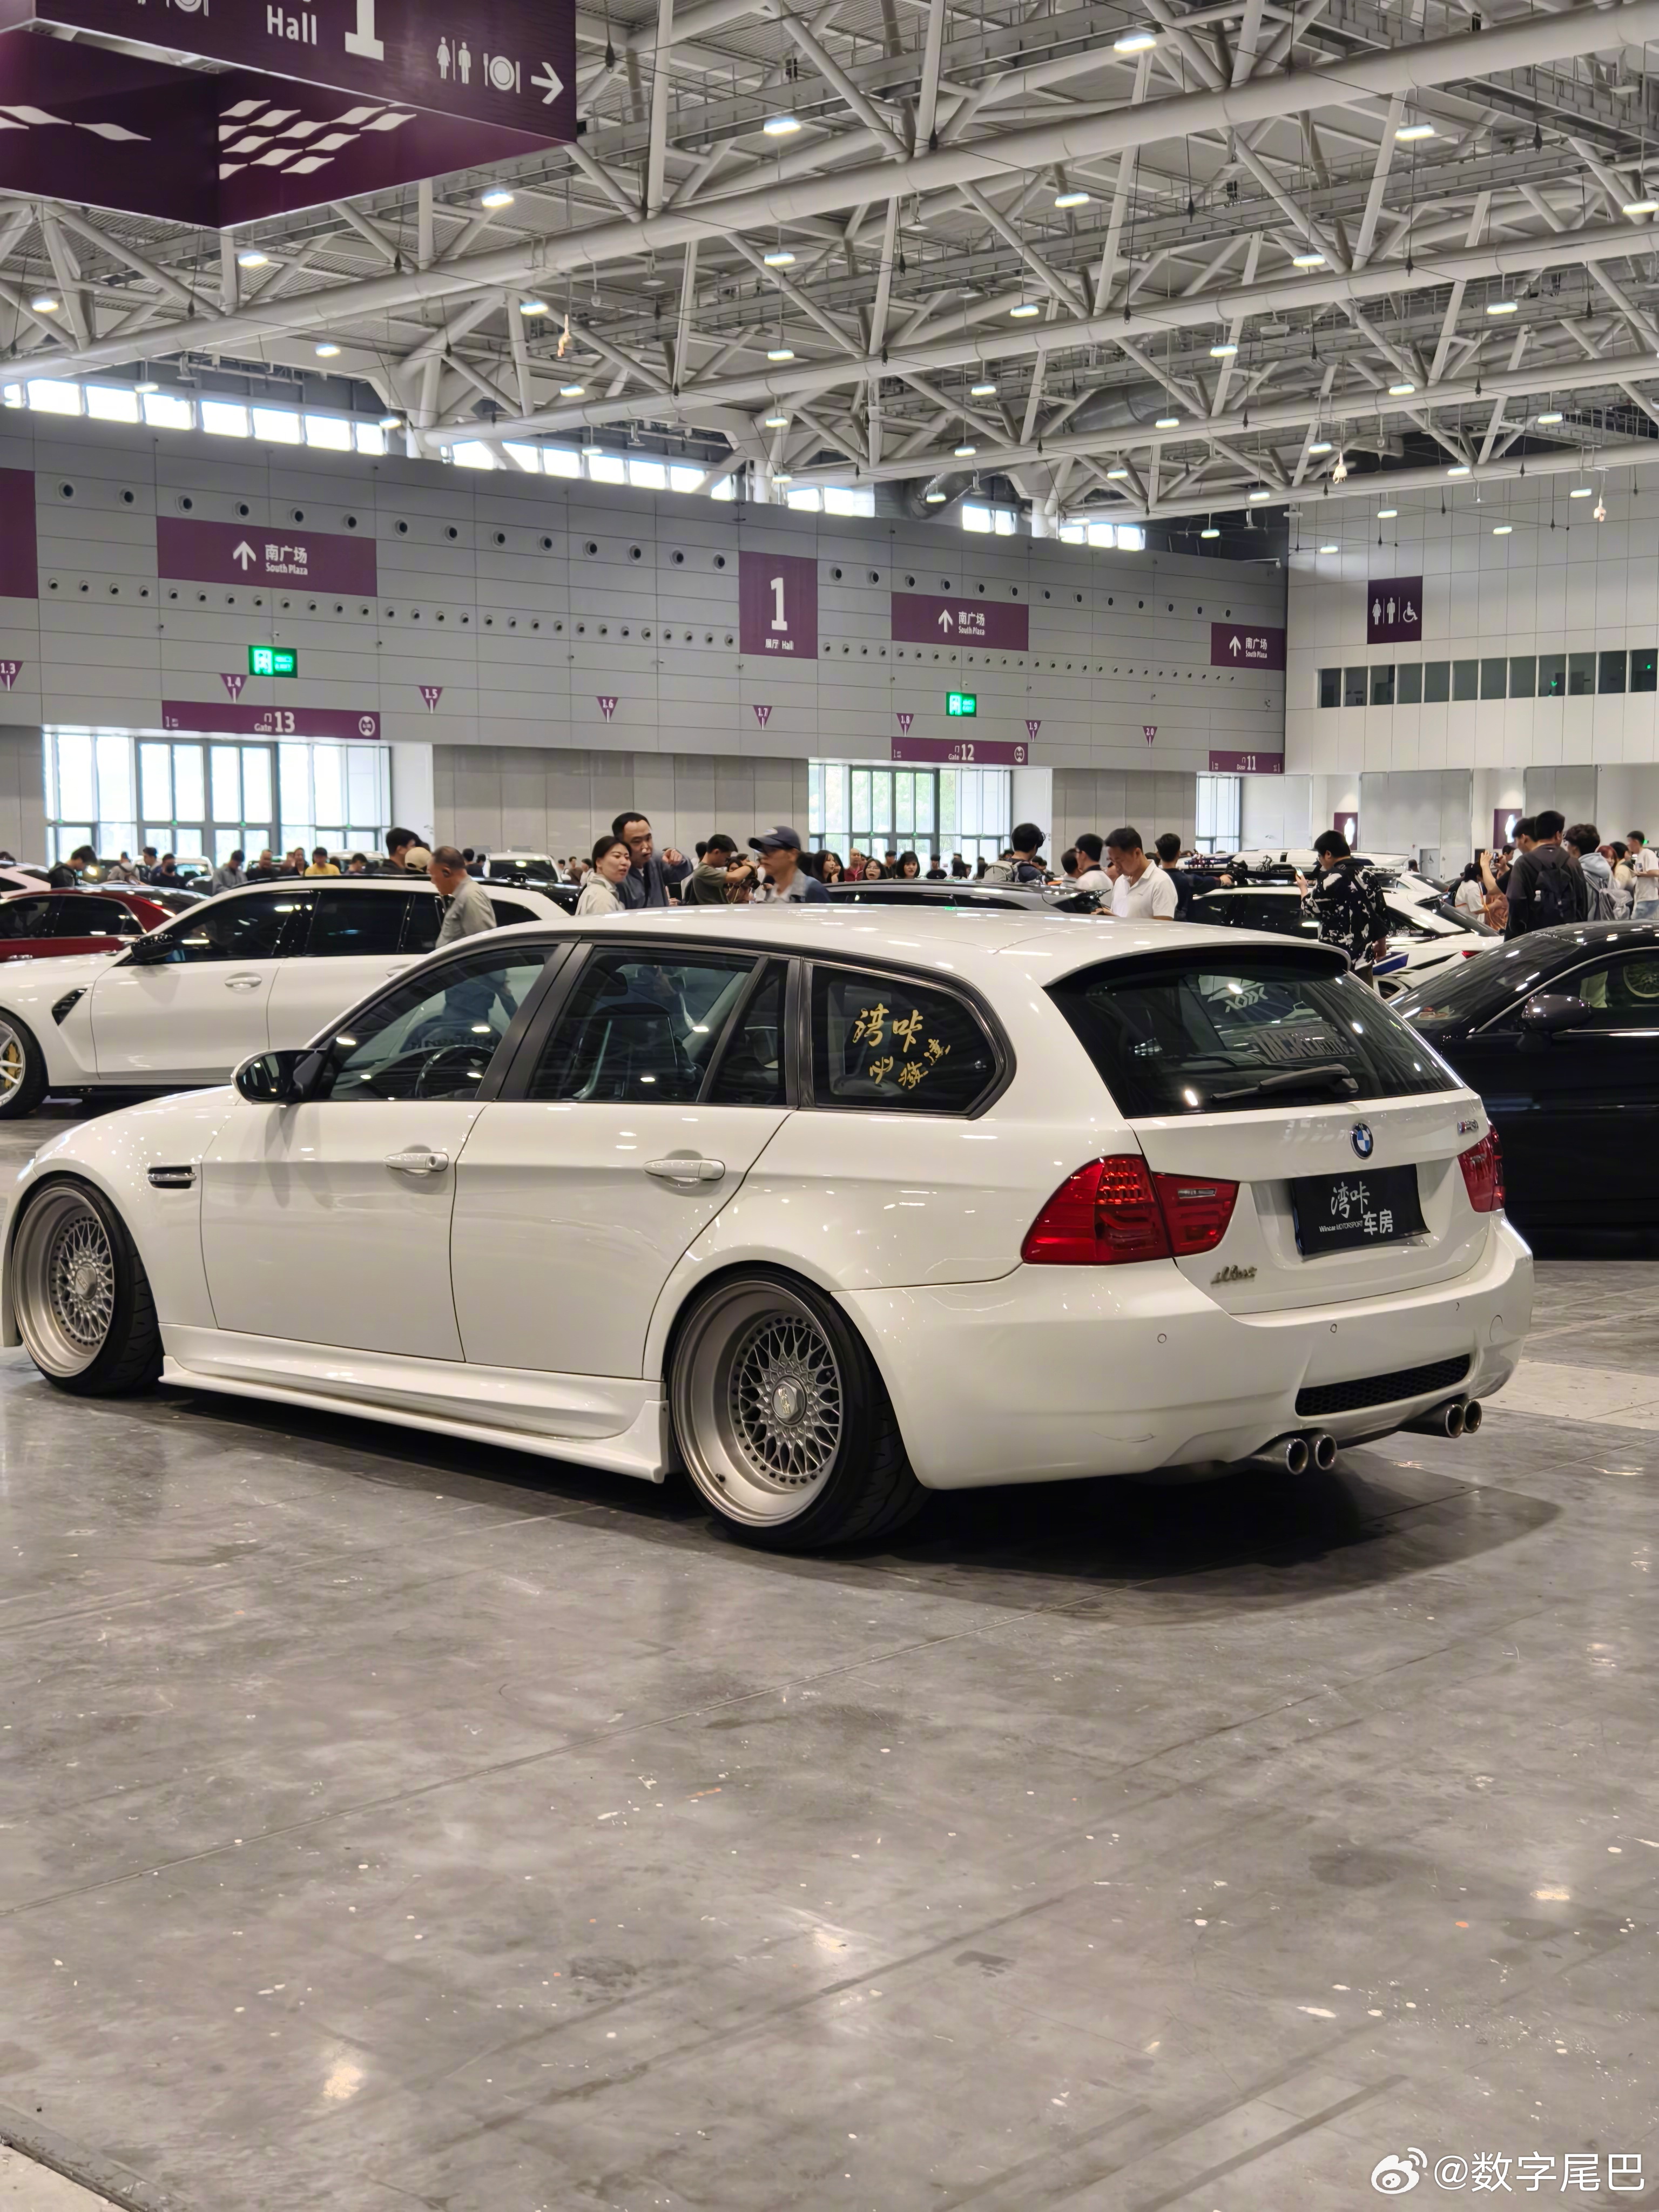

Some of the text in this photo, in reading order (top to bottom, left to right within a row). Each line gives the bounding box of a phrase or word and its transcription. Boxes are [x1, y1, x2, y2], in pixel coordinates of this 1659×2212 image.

[267, 4, 317, 45] Hall
[265, 544, 307, 564] 南广场
[265, 562, 288, 573] South
[771, 577, 788, 631] 1
[958, 611, 985, 626] 南广场
[958, 625, 985, 636] South Plaza
[781, 640, 794, 650] Hall
[1245, 637, 1267, 650] 南广场
[1245, 650, 1257, 658] South
[1, 662, 16, 675] 1.3
[227, 676, 241, 687] 1.4
[274, 711, 295, 733] 13
[1029, 722, 1037, 731] 1.9
[961, 744, 974, 760] 12
[1247, 755, 1256, 771] 11
[1331, 1181, 1370, 1218] 湾咔
[1363, 1209, 1393, 1236] 车房
